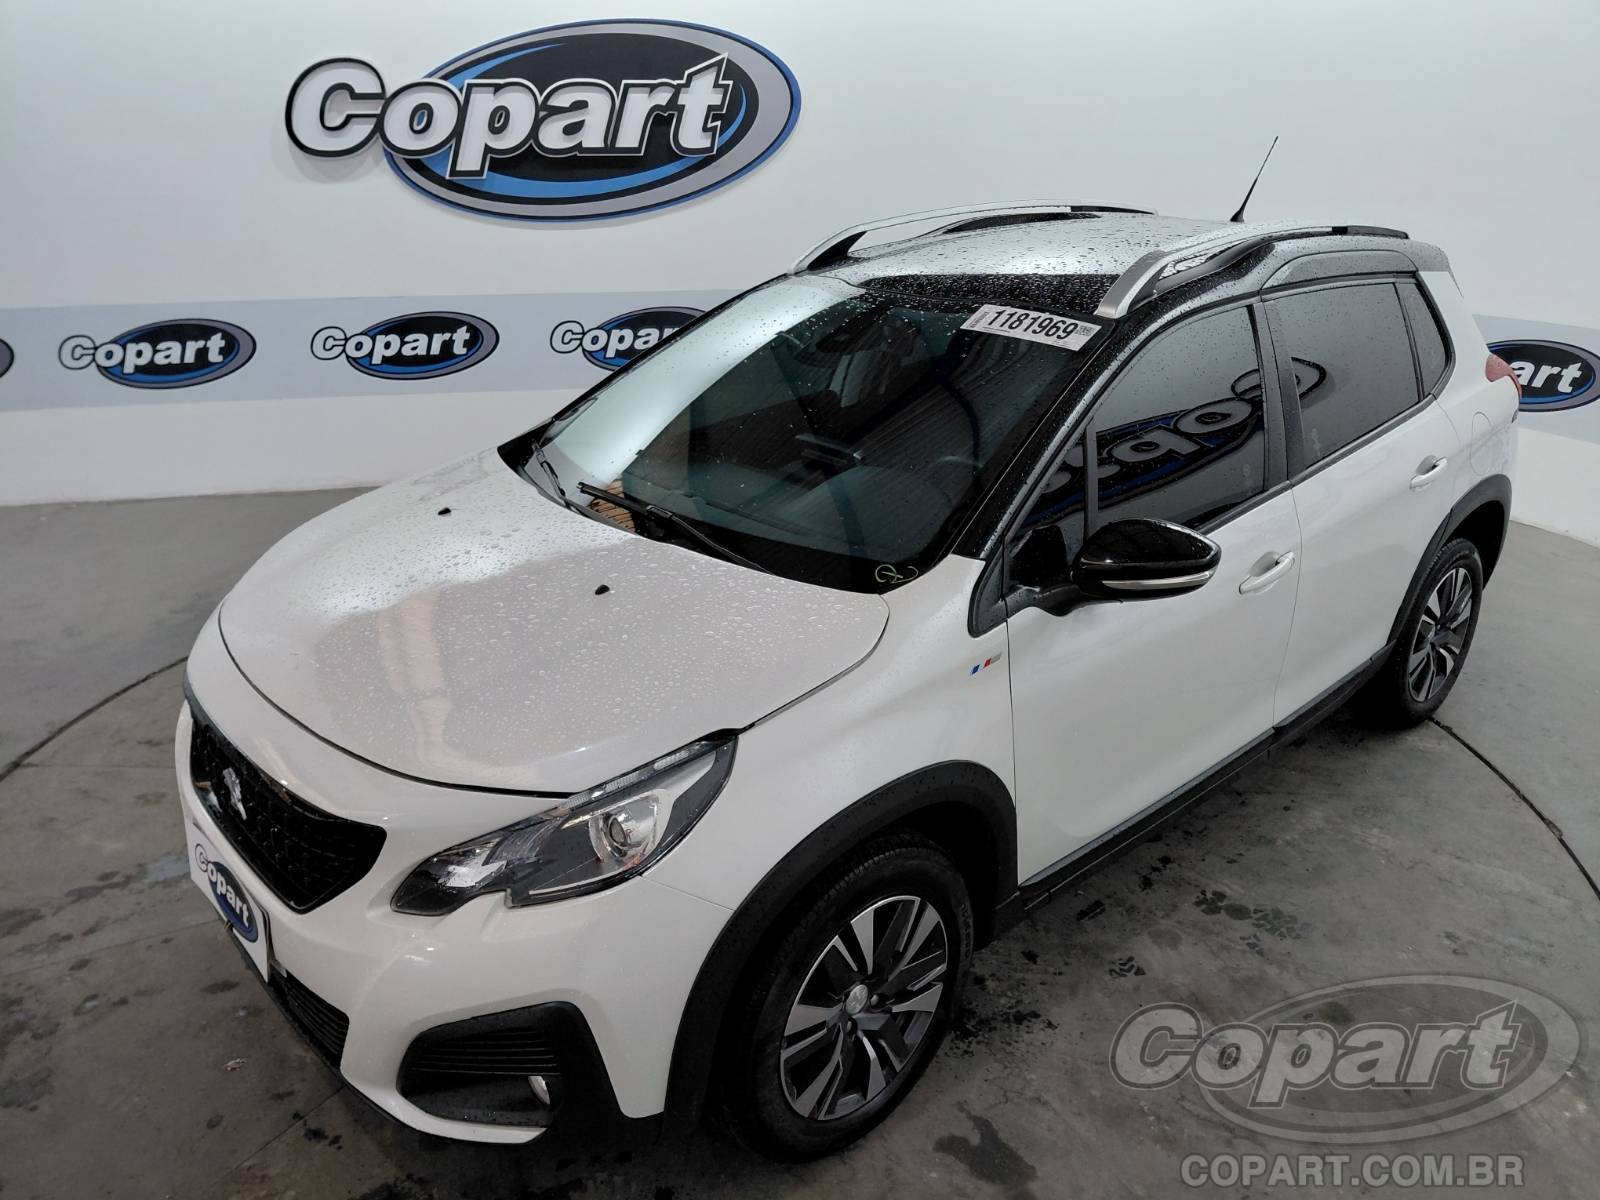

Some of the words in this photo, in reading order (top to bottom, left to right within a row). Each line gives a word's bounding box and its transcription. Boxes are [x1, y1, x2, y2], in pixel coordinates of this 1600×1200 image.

[285, 53, 733, 180] Copart
[550, 320, 681, 358] Copa
[987, 309, 1079, 340] 1181969
[59, 332, 226, 375] Copart
[311, 325, 470, 365] Copart
[1509, 361, 1582, 394] art
[195, 843, 250, 928] Copart
